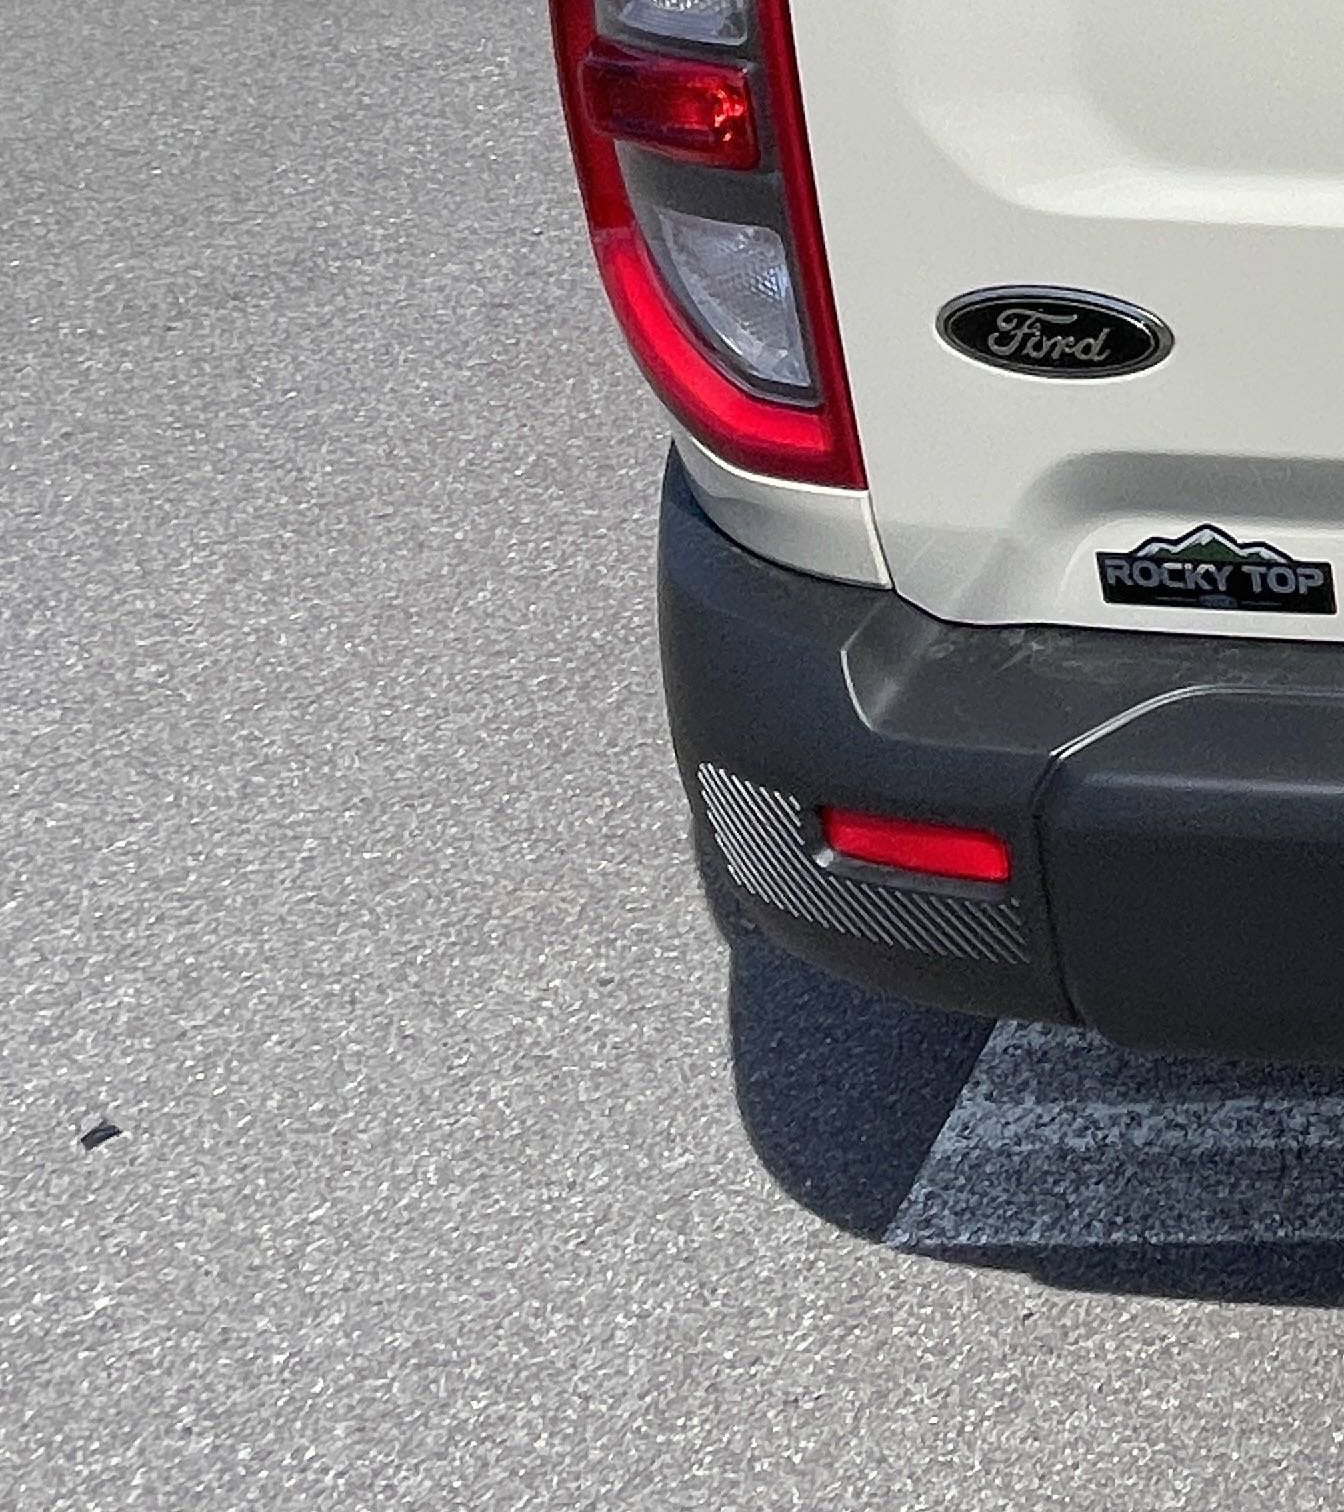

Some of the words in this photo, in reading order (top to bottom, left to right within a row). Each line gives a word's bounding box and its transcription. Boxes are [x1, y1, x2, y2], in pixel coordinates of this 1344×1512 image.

[987, 307, 1112, 363] Ford
[1105, 558, 1234, 593] ROCKY
[1241, 564, 1325, 596] TOP
